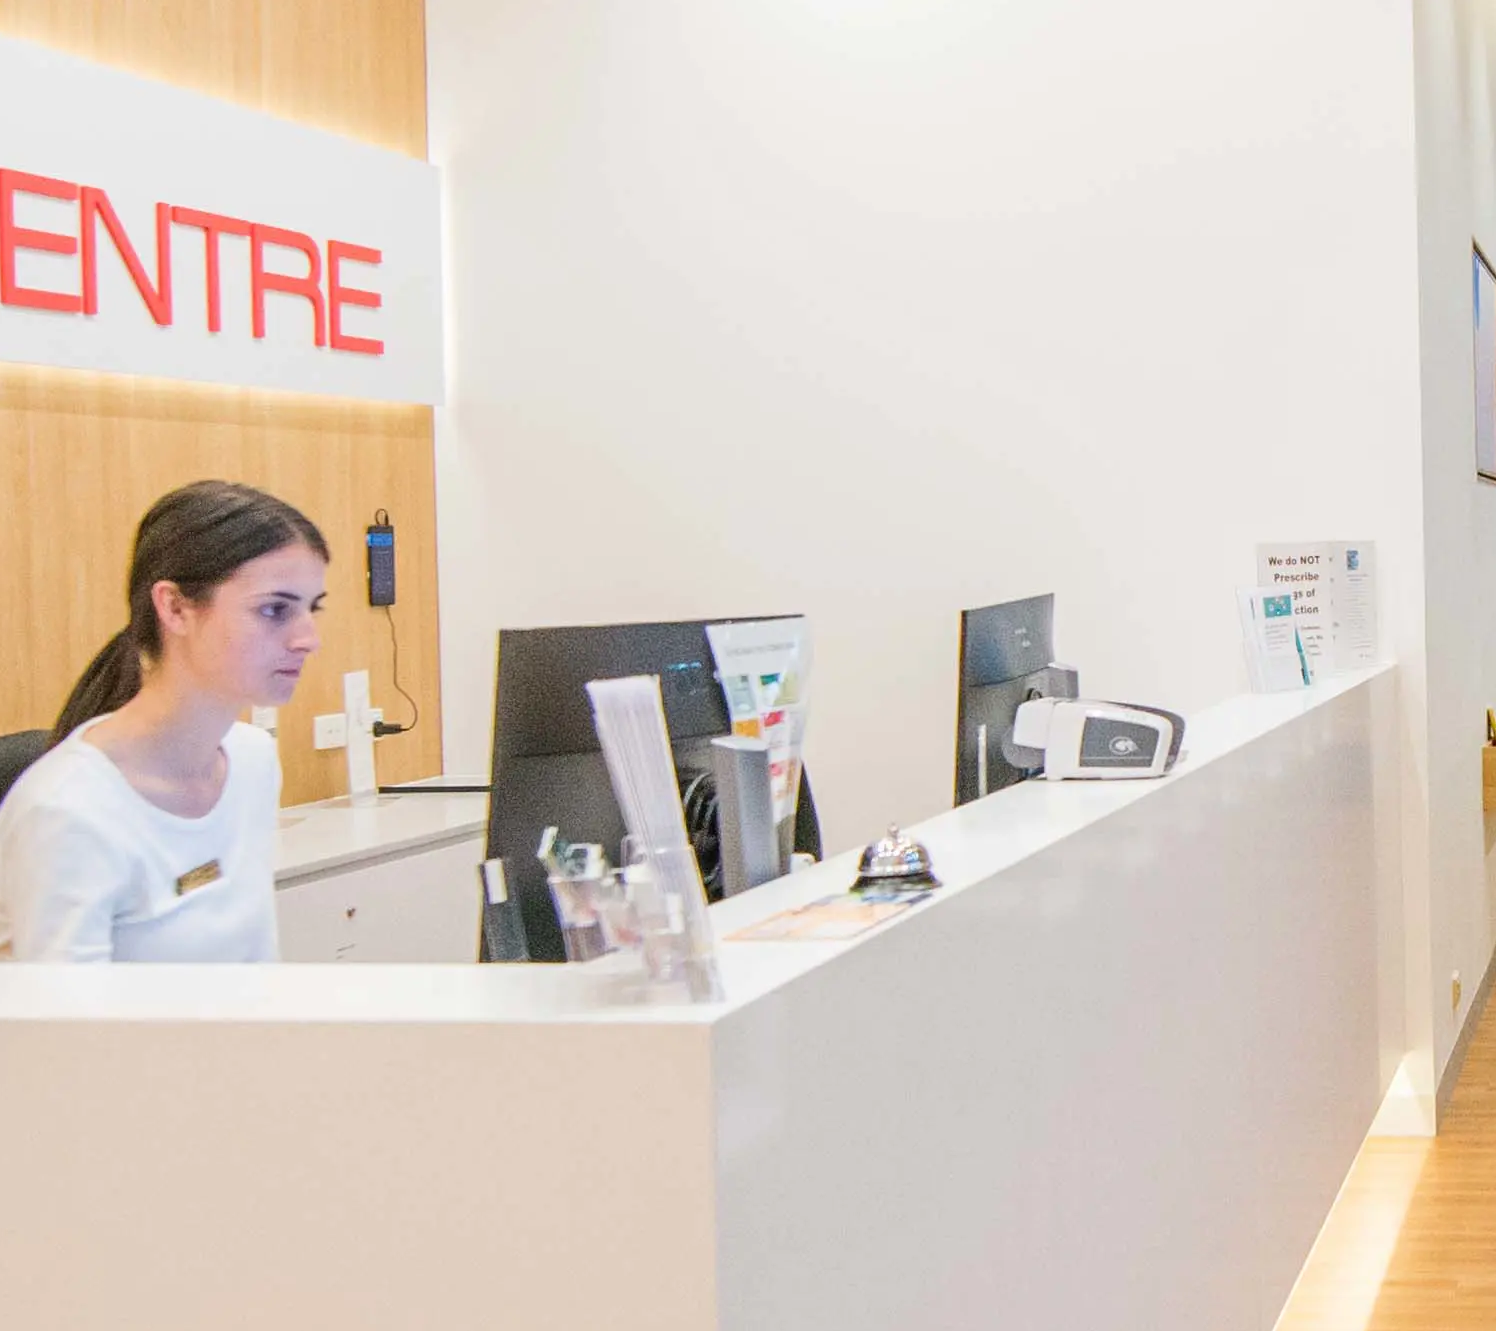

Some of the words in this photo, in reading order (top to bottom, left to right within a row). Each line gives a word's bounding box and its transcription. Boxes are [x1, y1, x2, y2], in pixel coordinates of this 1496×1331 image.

[1268, 556, 1283, 566] We
[1285, 556, 1297, 565] do
[1300, 555, 1320, 565] NOT
[1273, 572, 1320, 583] Prescribe
[1306, 588, 1316, 598] of
[1294, 605, 1319, 615] ction
